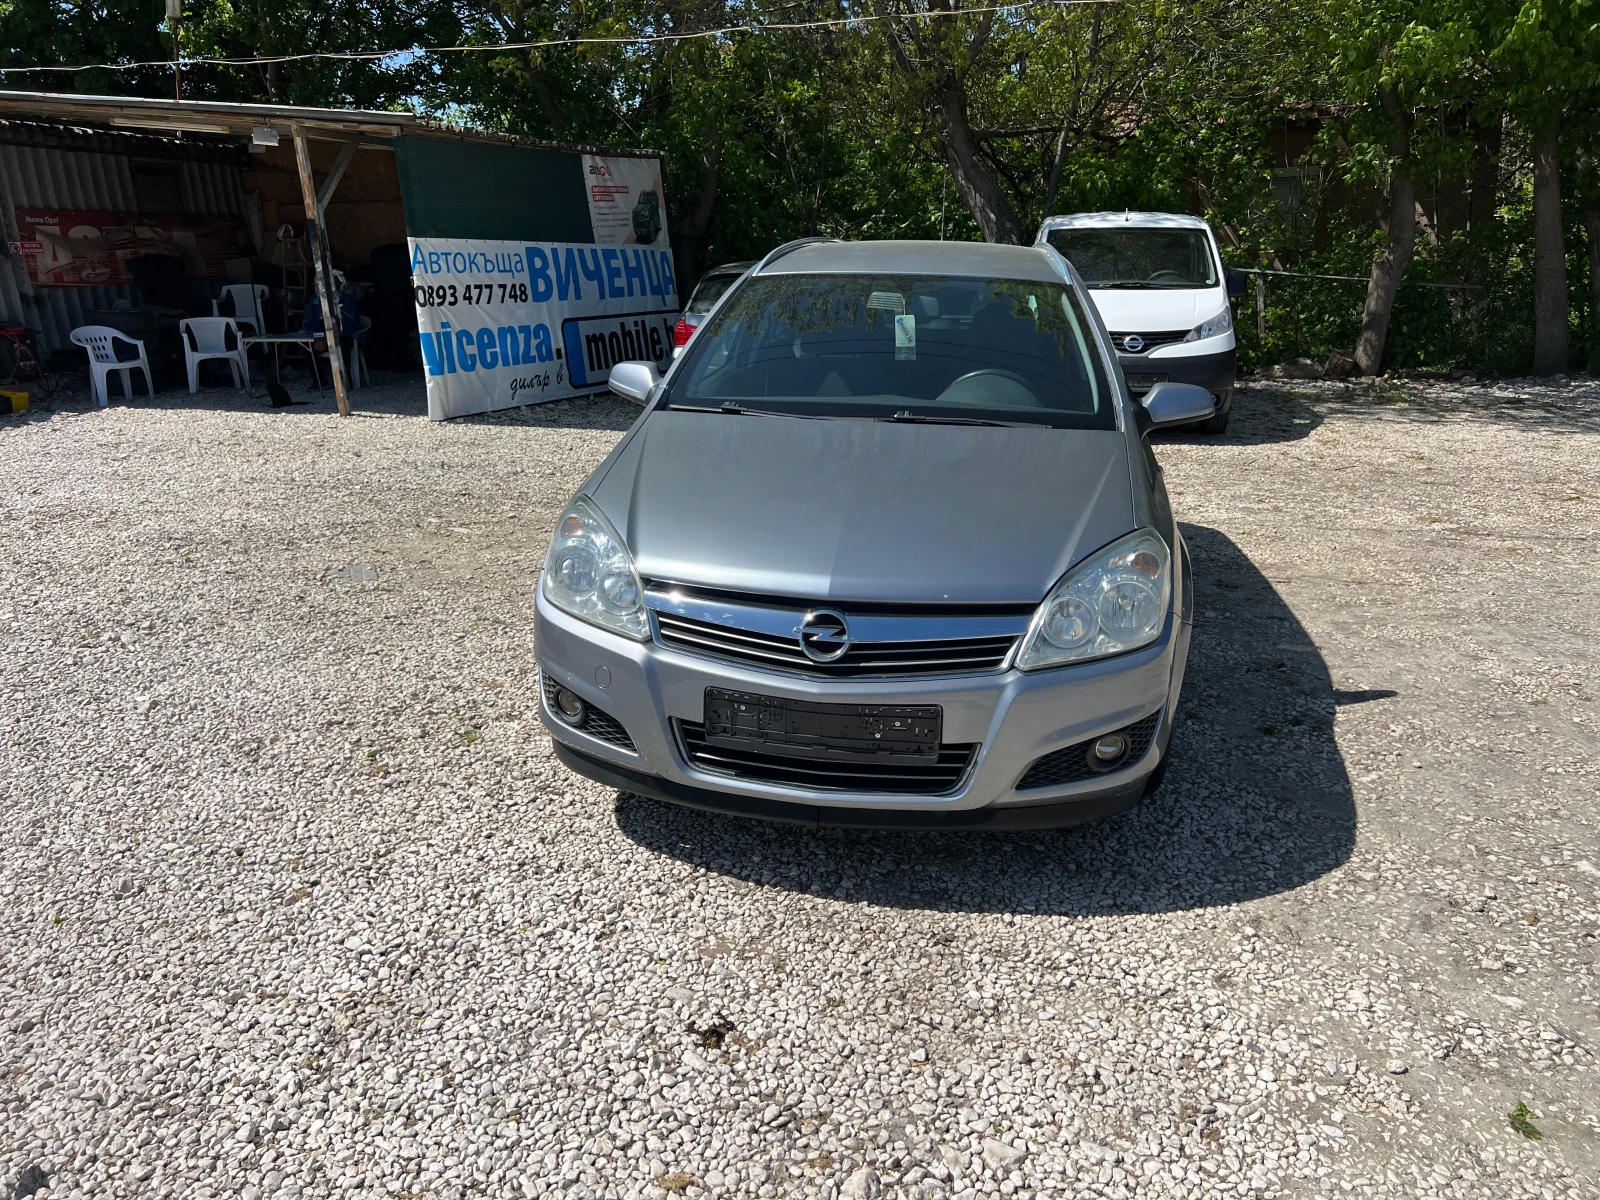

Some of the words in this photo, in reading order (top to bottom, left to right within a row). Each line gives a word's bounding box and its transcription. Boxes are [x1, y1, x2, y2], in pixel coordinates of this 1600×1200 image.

[45, 216, 60, 224] Opel
[525, 247, 678, 307] ВИЧЕНЦА
[414, 285, 458, 308] 0893
[463, 284, 494, 305] 477
[498, 283, 529, 304] 748
